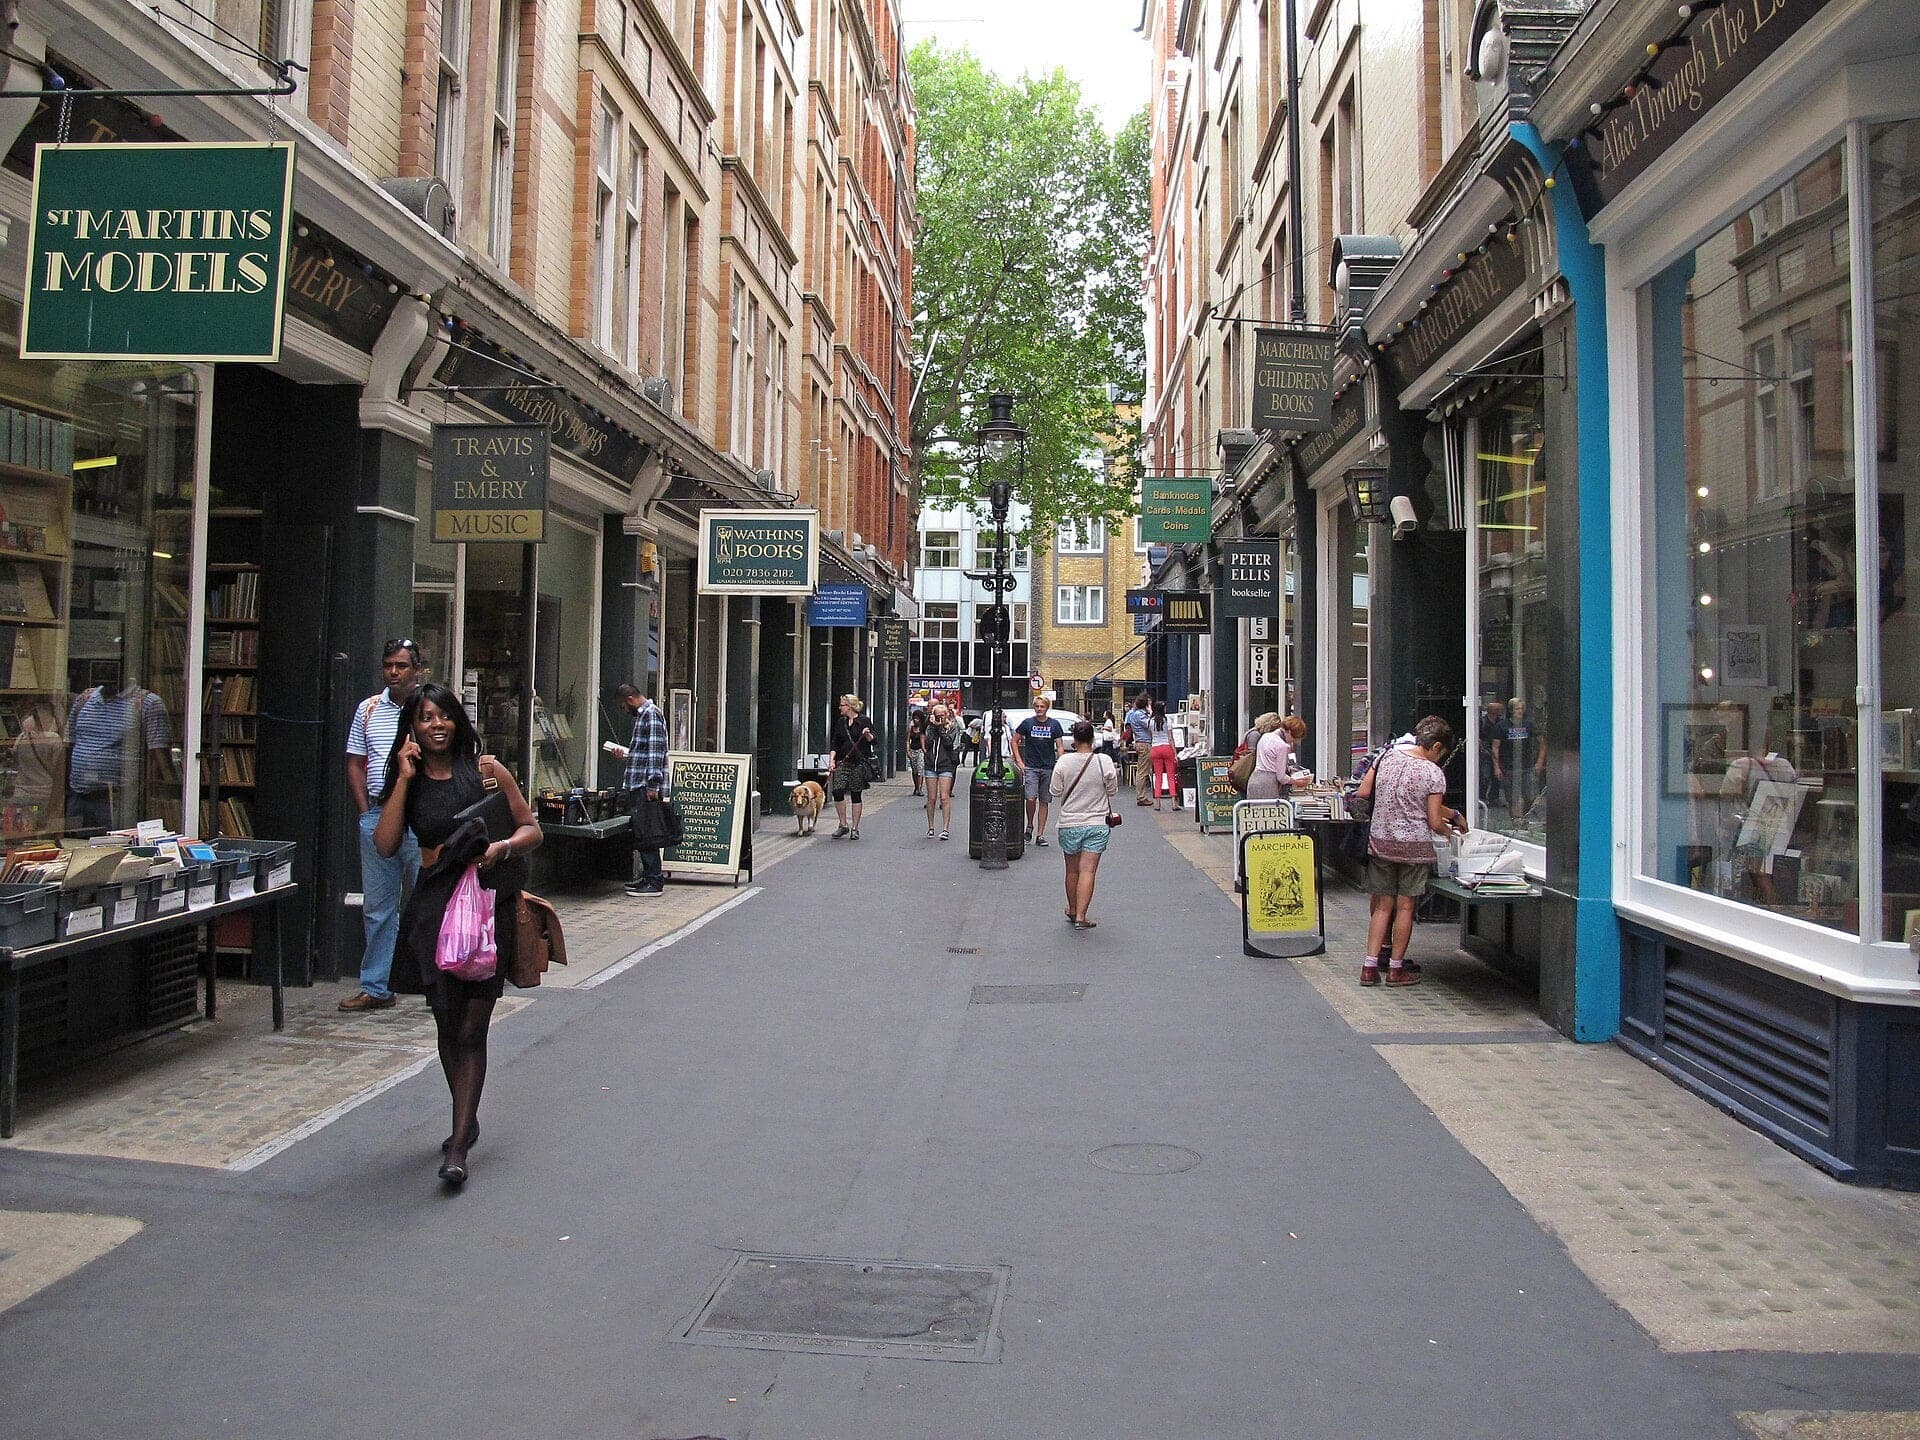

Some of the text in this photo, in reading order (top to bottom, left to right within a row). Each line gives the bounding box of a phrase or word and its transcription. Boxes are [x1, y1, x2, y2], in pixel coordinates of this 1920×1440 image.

[1601, 118, 1637, 181] Alice
[1631, 35, 1706, 142] Through
[1702, 2, 1748, 70] The
[73, 209, 272, 241] MARTINS
[42, 251, 269, 295] MODELS
[288, 245, 364, 313] MERY
[1408, 250, 1502, 367] MARCHPANE
[1260, 341, 1331, 361] MARCHPANE
[1258, 369, 1329, 392] CHILDREN'S
[1271, 393, 1314, 413] BOOKS
[504, 378, 608, 456] WATKINS BOOKS
[451, 437, 533, 456] TRAVIS
[481, 459, 500, 478] &
[454, 480, 528, 499] EMERY
[1153, 490, 1200, 500] Banknotes
[1146, 505, 1206, 515] Cards Medals
[451, 514, 529, 534] MUSIC
[1163, 521, 1189, 530] Coins
[734, 529, 804, 542] WATKINS
[735, 544, 804, 560] BOOKS
[1230, 553, 1272, 566] PETER
[722, 568, 794, 578] 020 7836 2182
[1230, 568, 1271, 581] ELLIS
[1231, 588, 1272, 598] bookseller
[1255, 646, 1264, 685] COINS
[921, 681, 959, 689] HEAVEN
[686, 763, 736, 774] WATKINS
[685, 772, 735, 782] ESOTERIC
[684, 780, 733, 791] CENTRE
[1206, 784, 1238, 796] COINS
[673, 796, 732, 805] CONSULTATIONS
[677, 791, 731, 800] ASTROLOGICAL
[1243, 807, 1287, 819] PETER
[684, 818, 720, 826] CRYSTALS
[1244, 819, 1288, 832] ELLIS
[698, 842, 730, 850] CANDLES
[1251, 842, 1310, 852] MARCHPANE
[675, 849, 719, 857] MEDITATION
